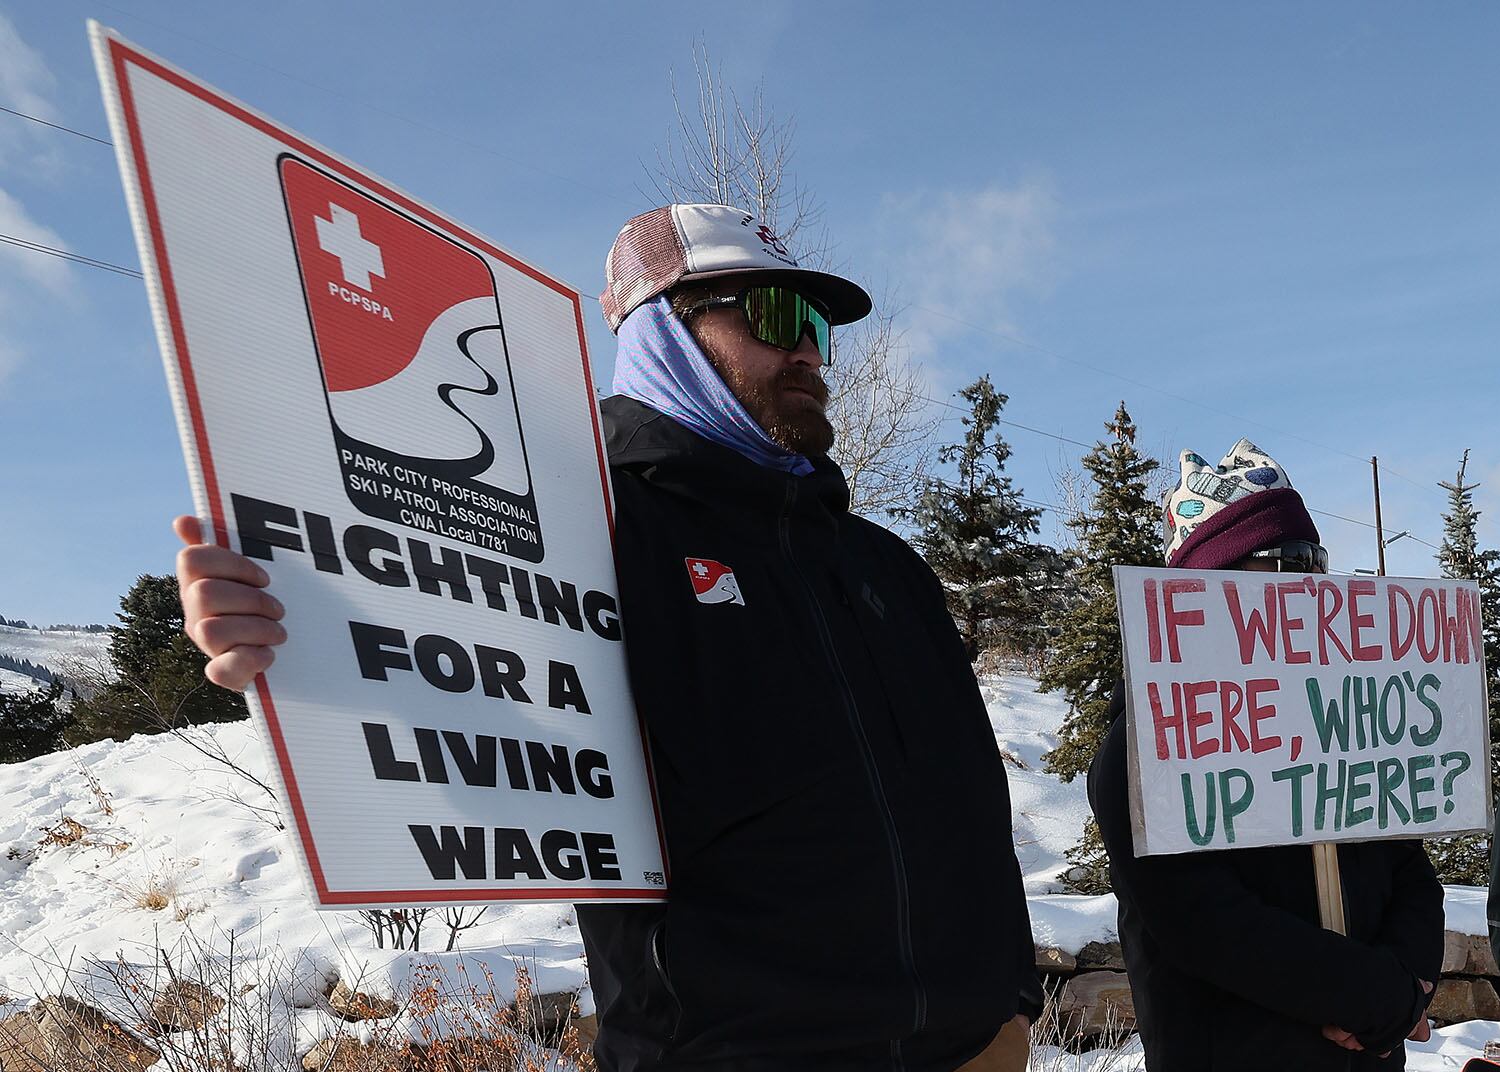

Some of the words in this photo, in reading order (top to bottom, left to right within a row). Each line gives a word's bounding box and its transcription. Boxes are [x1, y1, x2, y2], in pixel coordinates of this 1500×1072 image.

[328, 281, 394, 322] PCPSPA
[341, 449, 390, 478] PARK
[393, 466, 428, 489] CITY
[432, 477, 536, 525] PROFESSIONAL
[349, 474, 378, 496] SKI
[382, 483, 446, 516] PATROL
[450, 504, 538, 544] ASSOCIATION
[230, 492, 622, 642] FIGHTING
[400, 508, 437, 532] CWA
[439, 519, 476, 544] Local
[479, 531, 508, 553] 7781
[1143, 577, 1206, 664] IF
[1222, 575, 1383, 666] WE'RE
[1387, 582, 1481, 665] DOWN
[348, 620, 535, 704] FOR
[548, 659, 592, 715] A
[1147, 677, 1304, 762] HERE,
[1306, 670, 1442, 753] WHO'S
[361, 722, 614, 799] LIVING
[1180, 767, 1255, 847] UP
[1272, 751, 1471, 838] THERE?
[408, 824, 622, 881] WAGE
